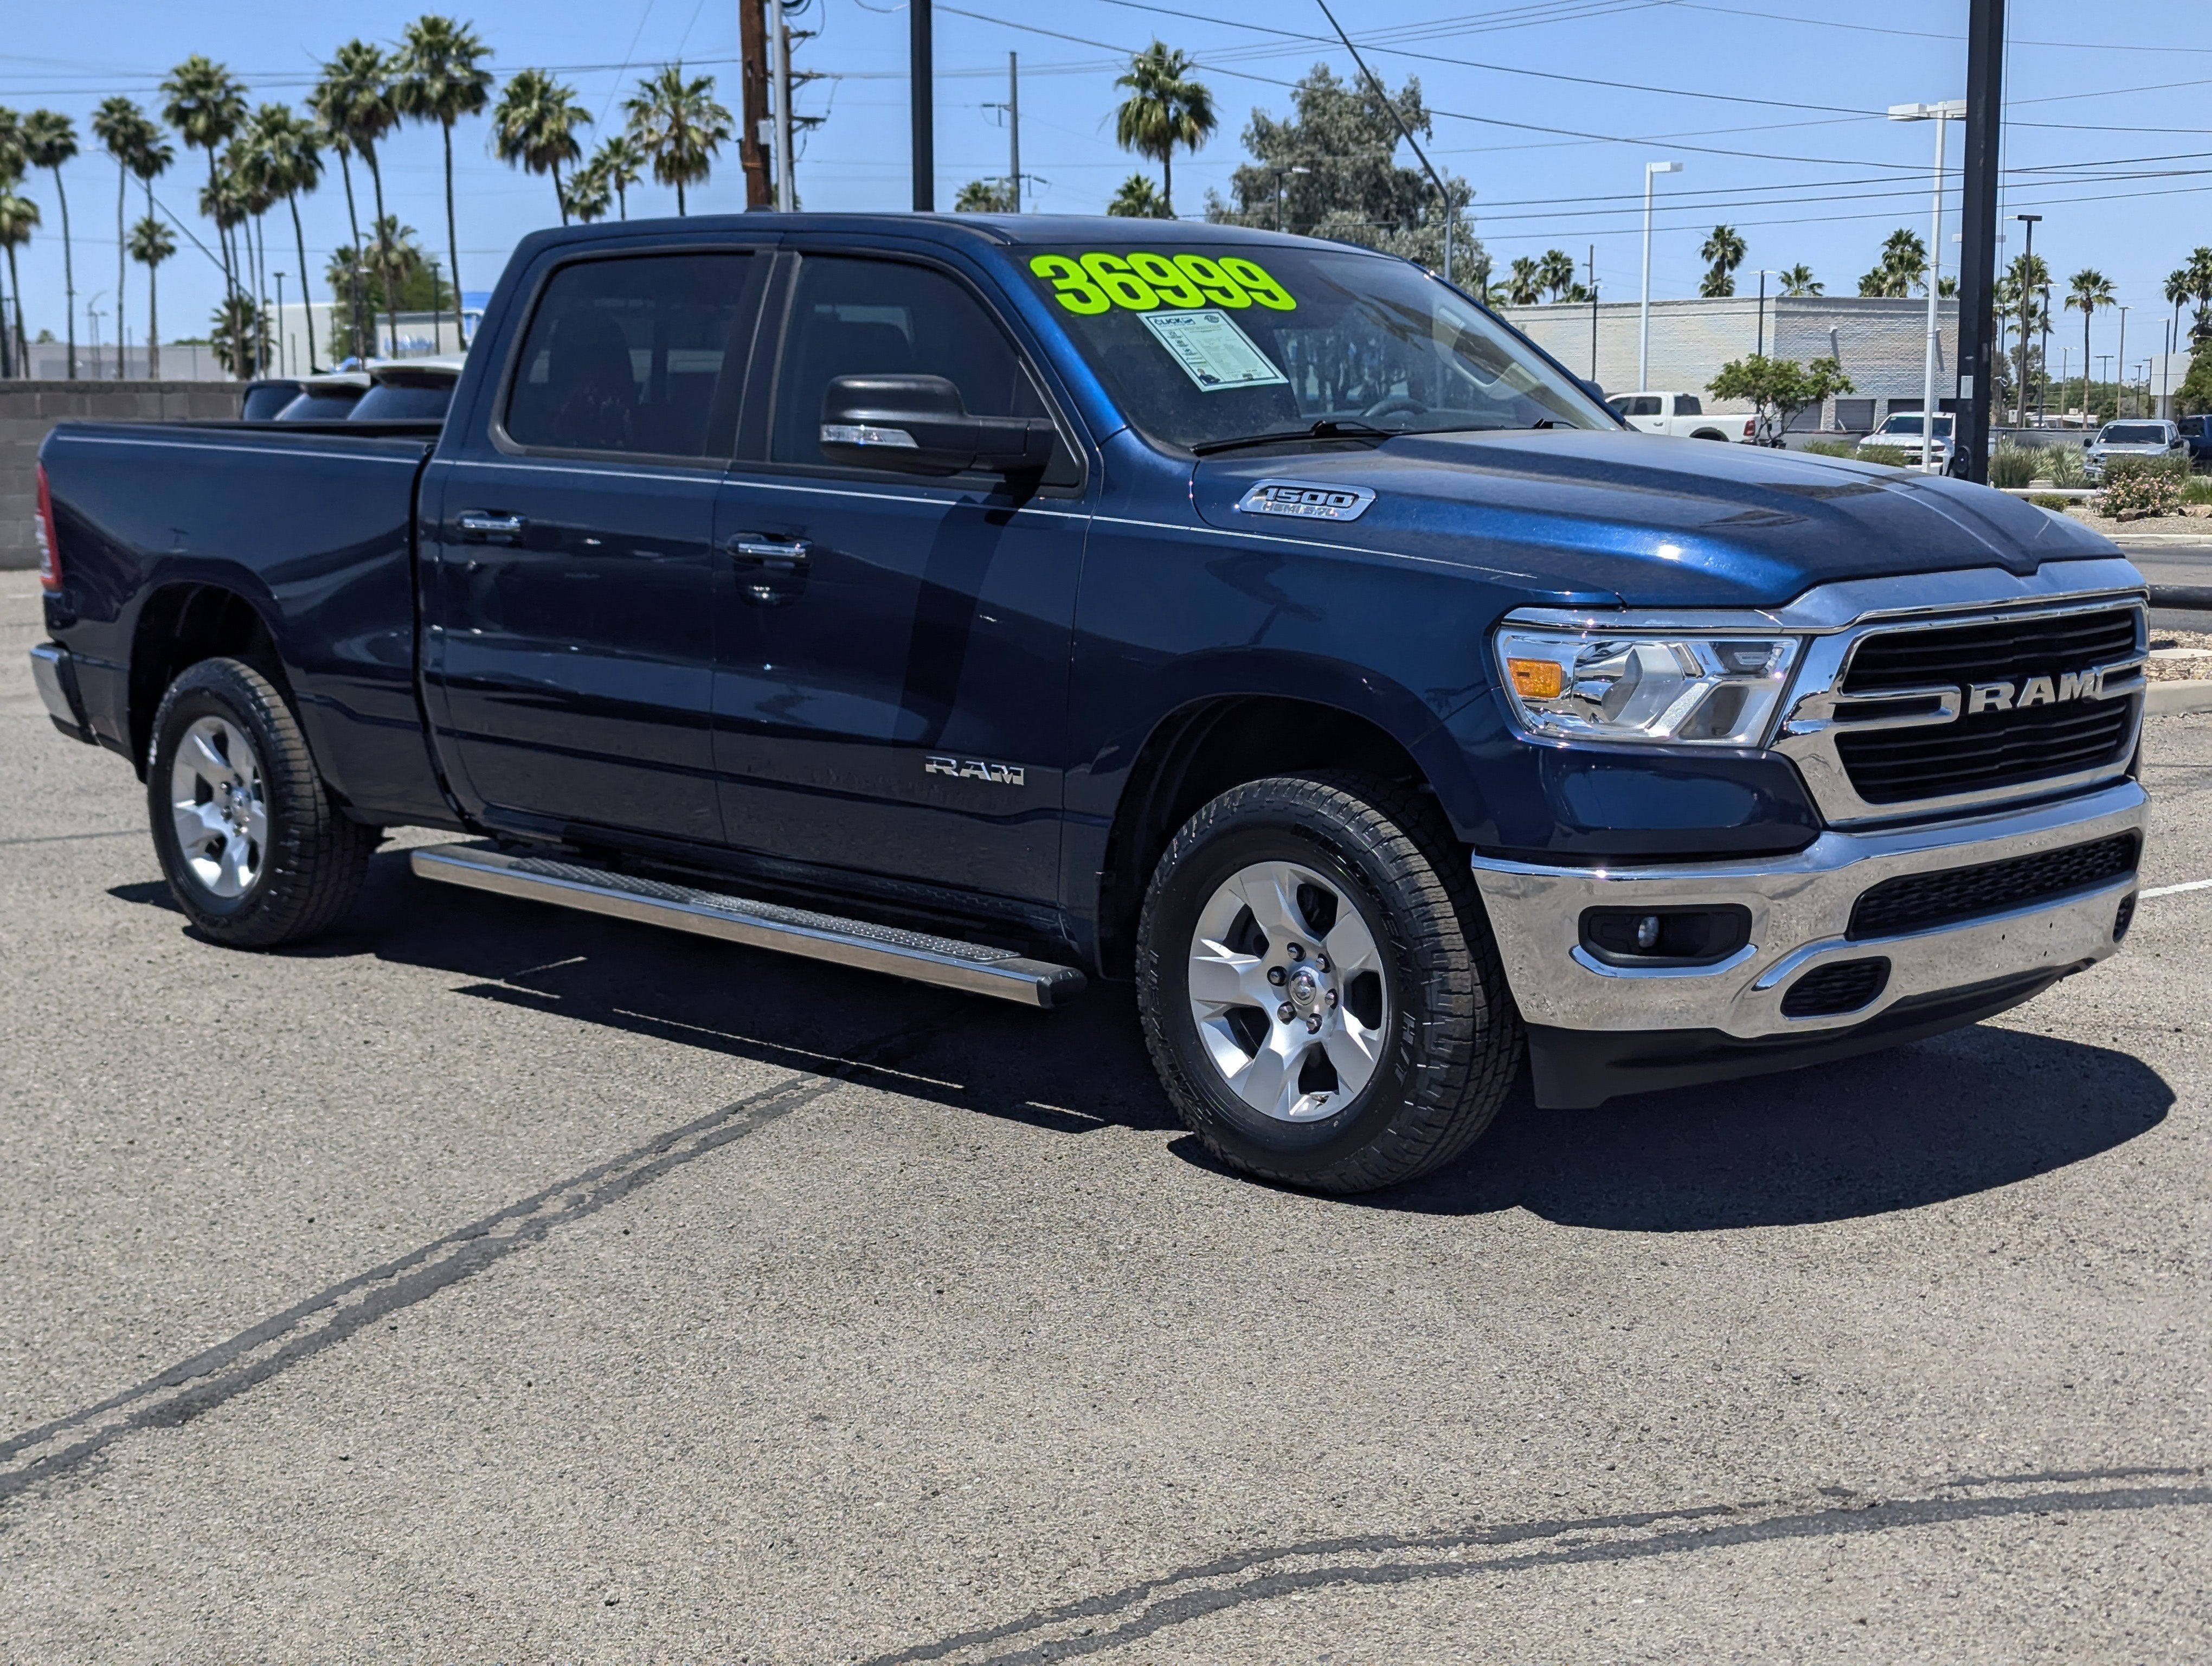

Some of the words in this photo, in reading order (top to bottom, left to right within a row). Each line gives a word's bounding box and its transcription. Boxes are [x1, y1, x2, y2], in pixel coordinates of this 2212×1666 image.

[1030, 251, 1297, 315] 36999
[1261, 501, 1300, 514] HEMI
[1265, 488, 1354, 508] 1500
[1969, 669, 2097, 715] RAM
[925, 756, 1024, 786] RAM
[1394, 1011, 1416, 1087] H/T
